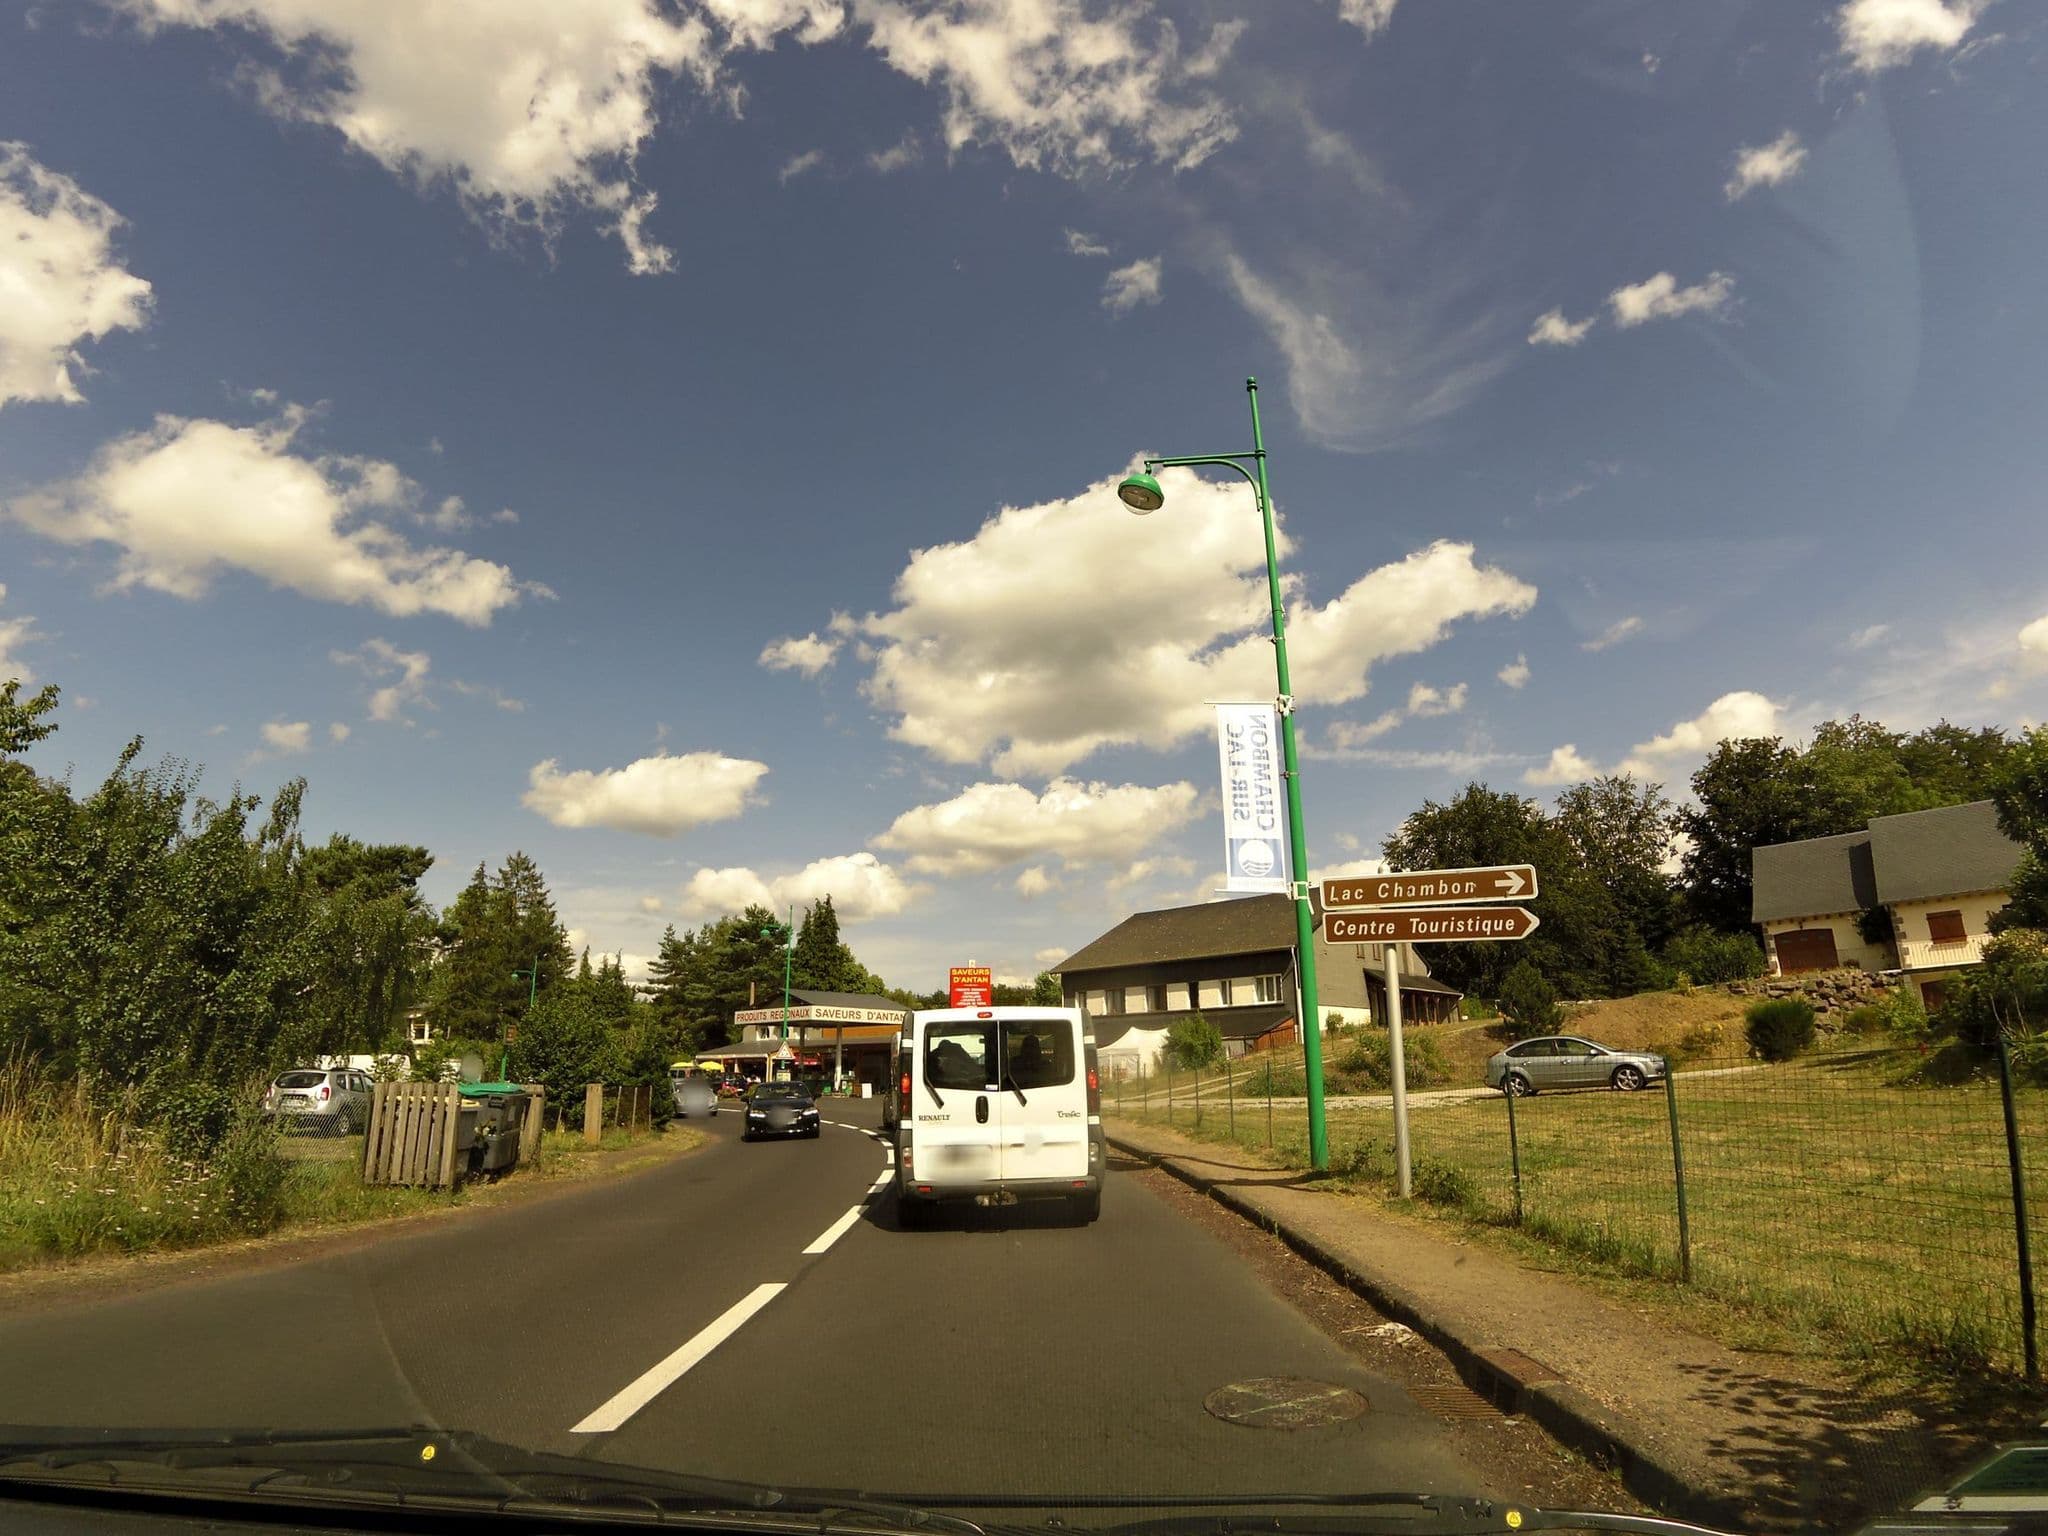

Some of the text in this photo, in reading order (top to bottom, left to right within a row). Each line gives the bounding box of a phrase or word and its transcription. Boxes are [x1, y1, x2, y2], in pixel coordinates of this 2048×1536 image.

[1329, 879, 1477, 902] Lac Chambon
[1333, 916, 1515, 938] Centre Touristique
[953, 976, 989, 984] D'ANTAN
[736, 1008, 810, 1022] PRODUITS REGONAUX
[815, 1008, 861, 1020] SAVEURS
[918, 1114, 951, 1122] RENAULT
